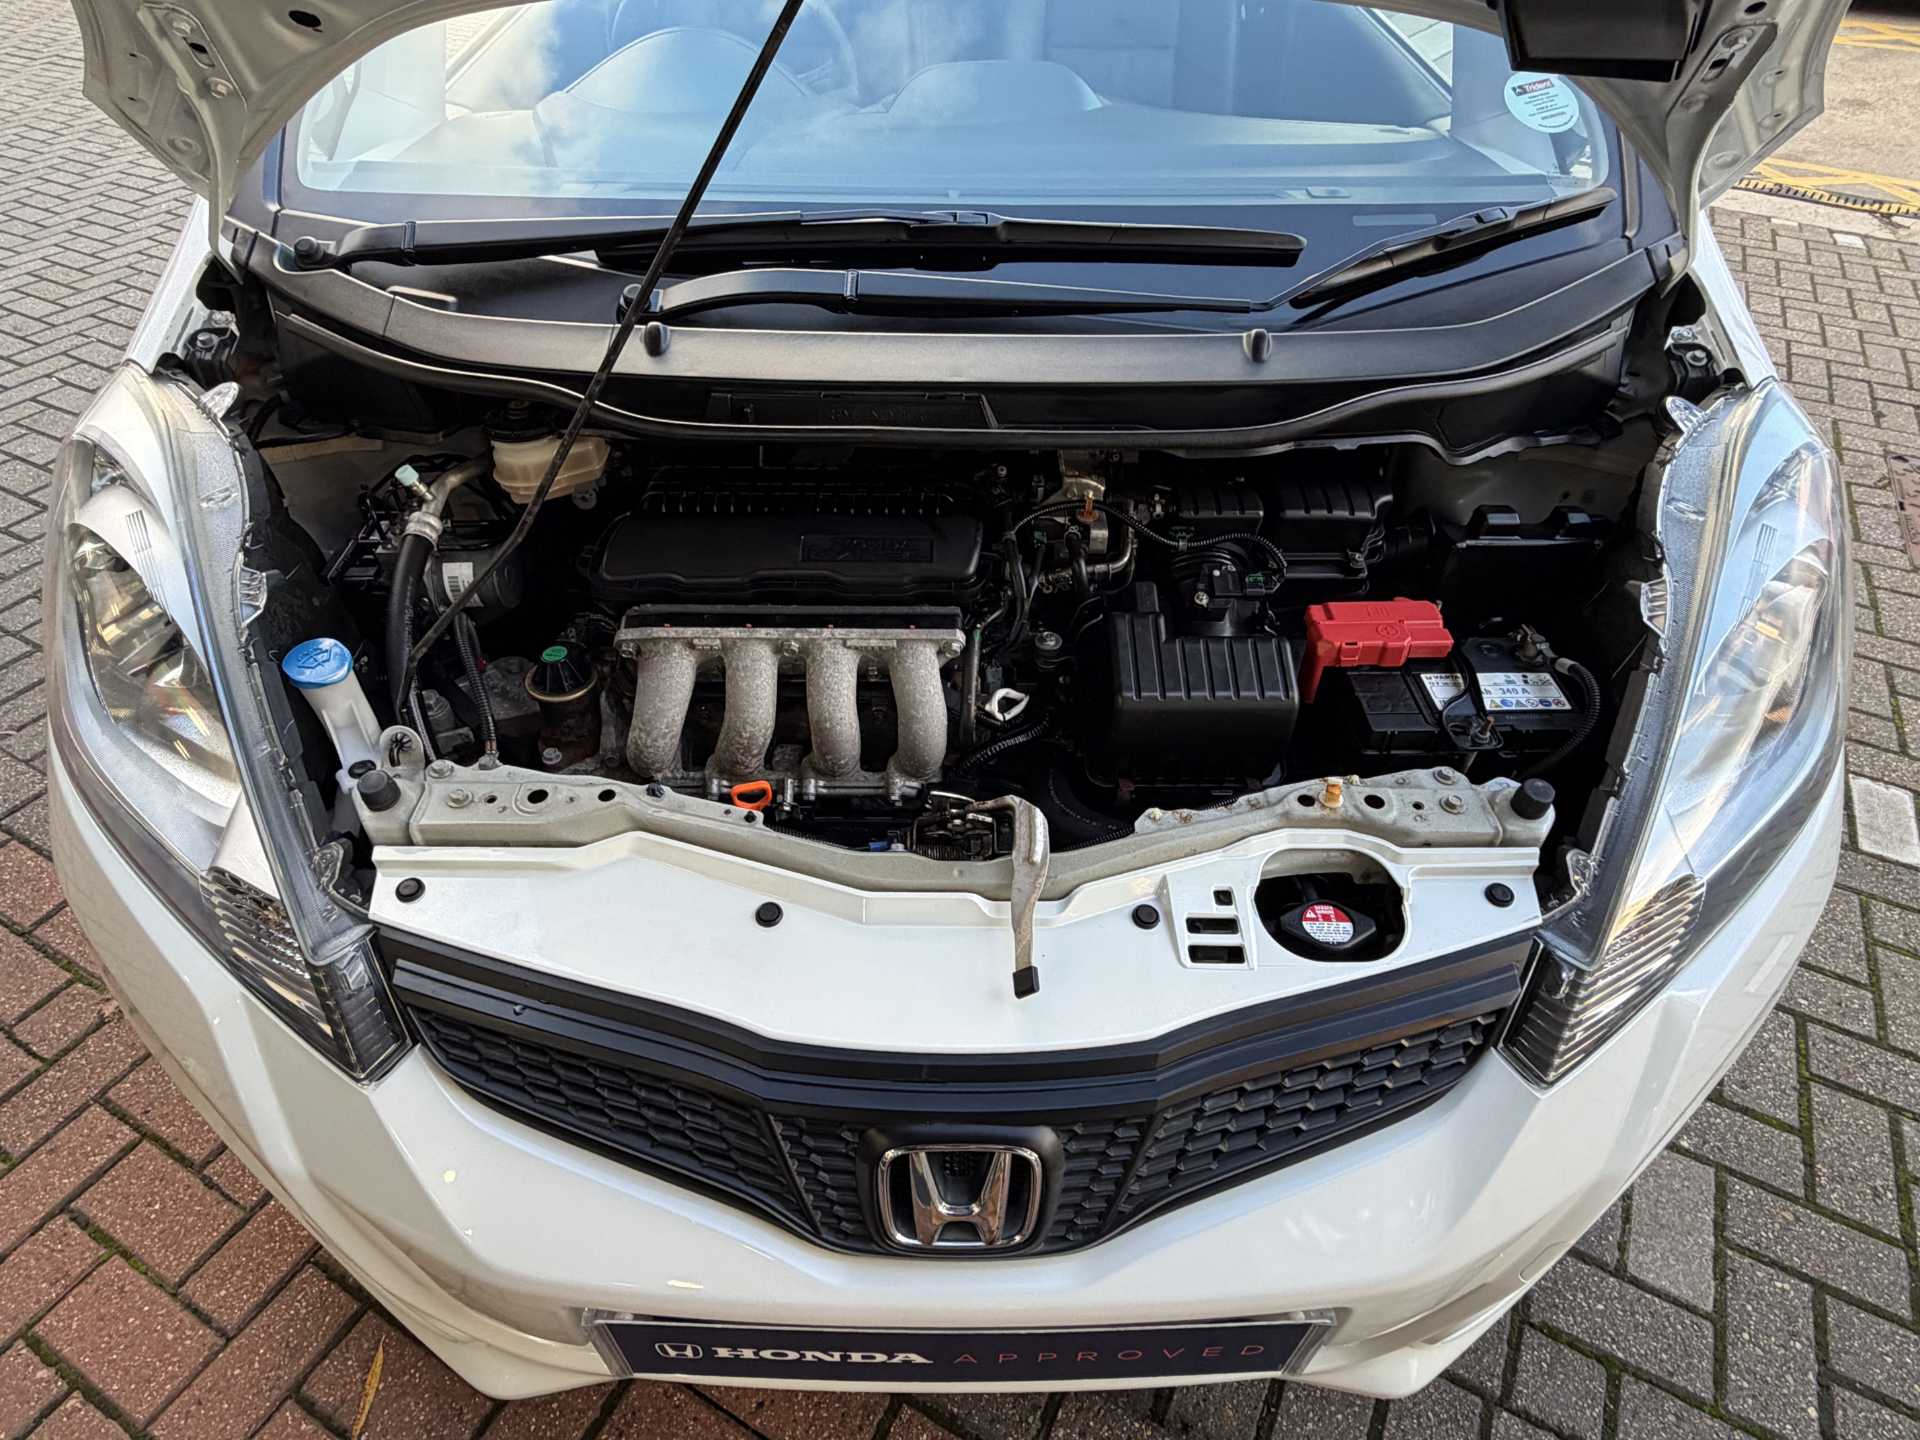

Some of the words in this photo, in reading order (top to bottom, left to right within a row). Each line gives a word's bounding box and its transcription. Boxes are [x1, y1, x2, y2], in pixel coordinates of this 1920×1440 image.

[1526, 80, 1553, 92] Trident
[711, 1346, 934, 1364] HONDA
[953, 1344, 1265, 1364] APPROVED
